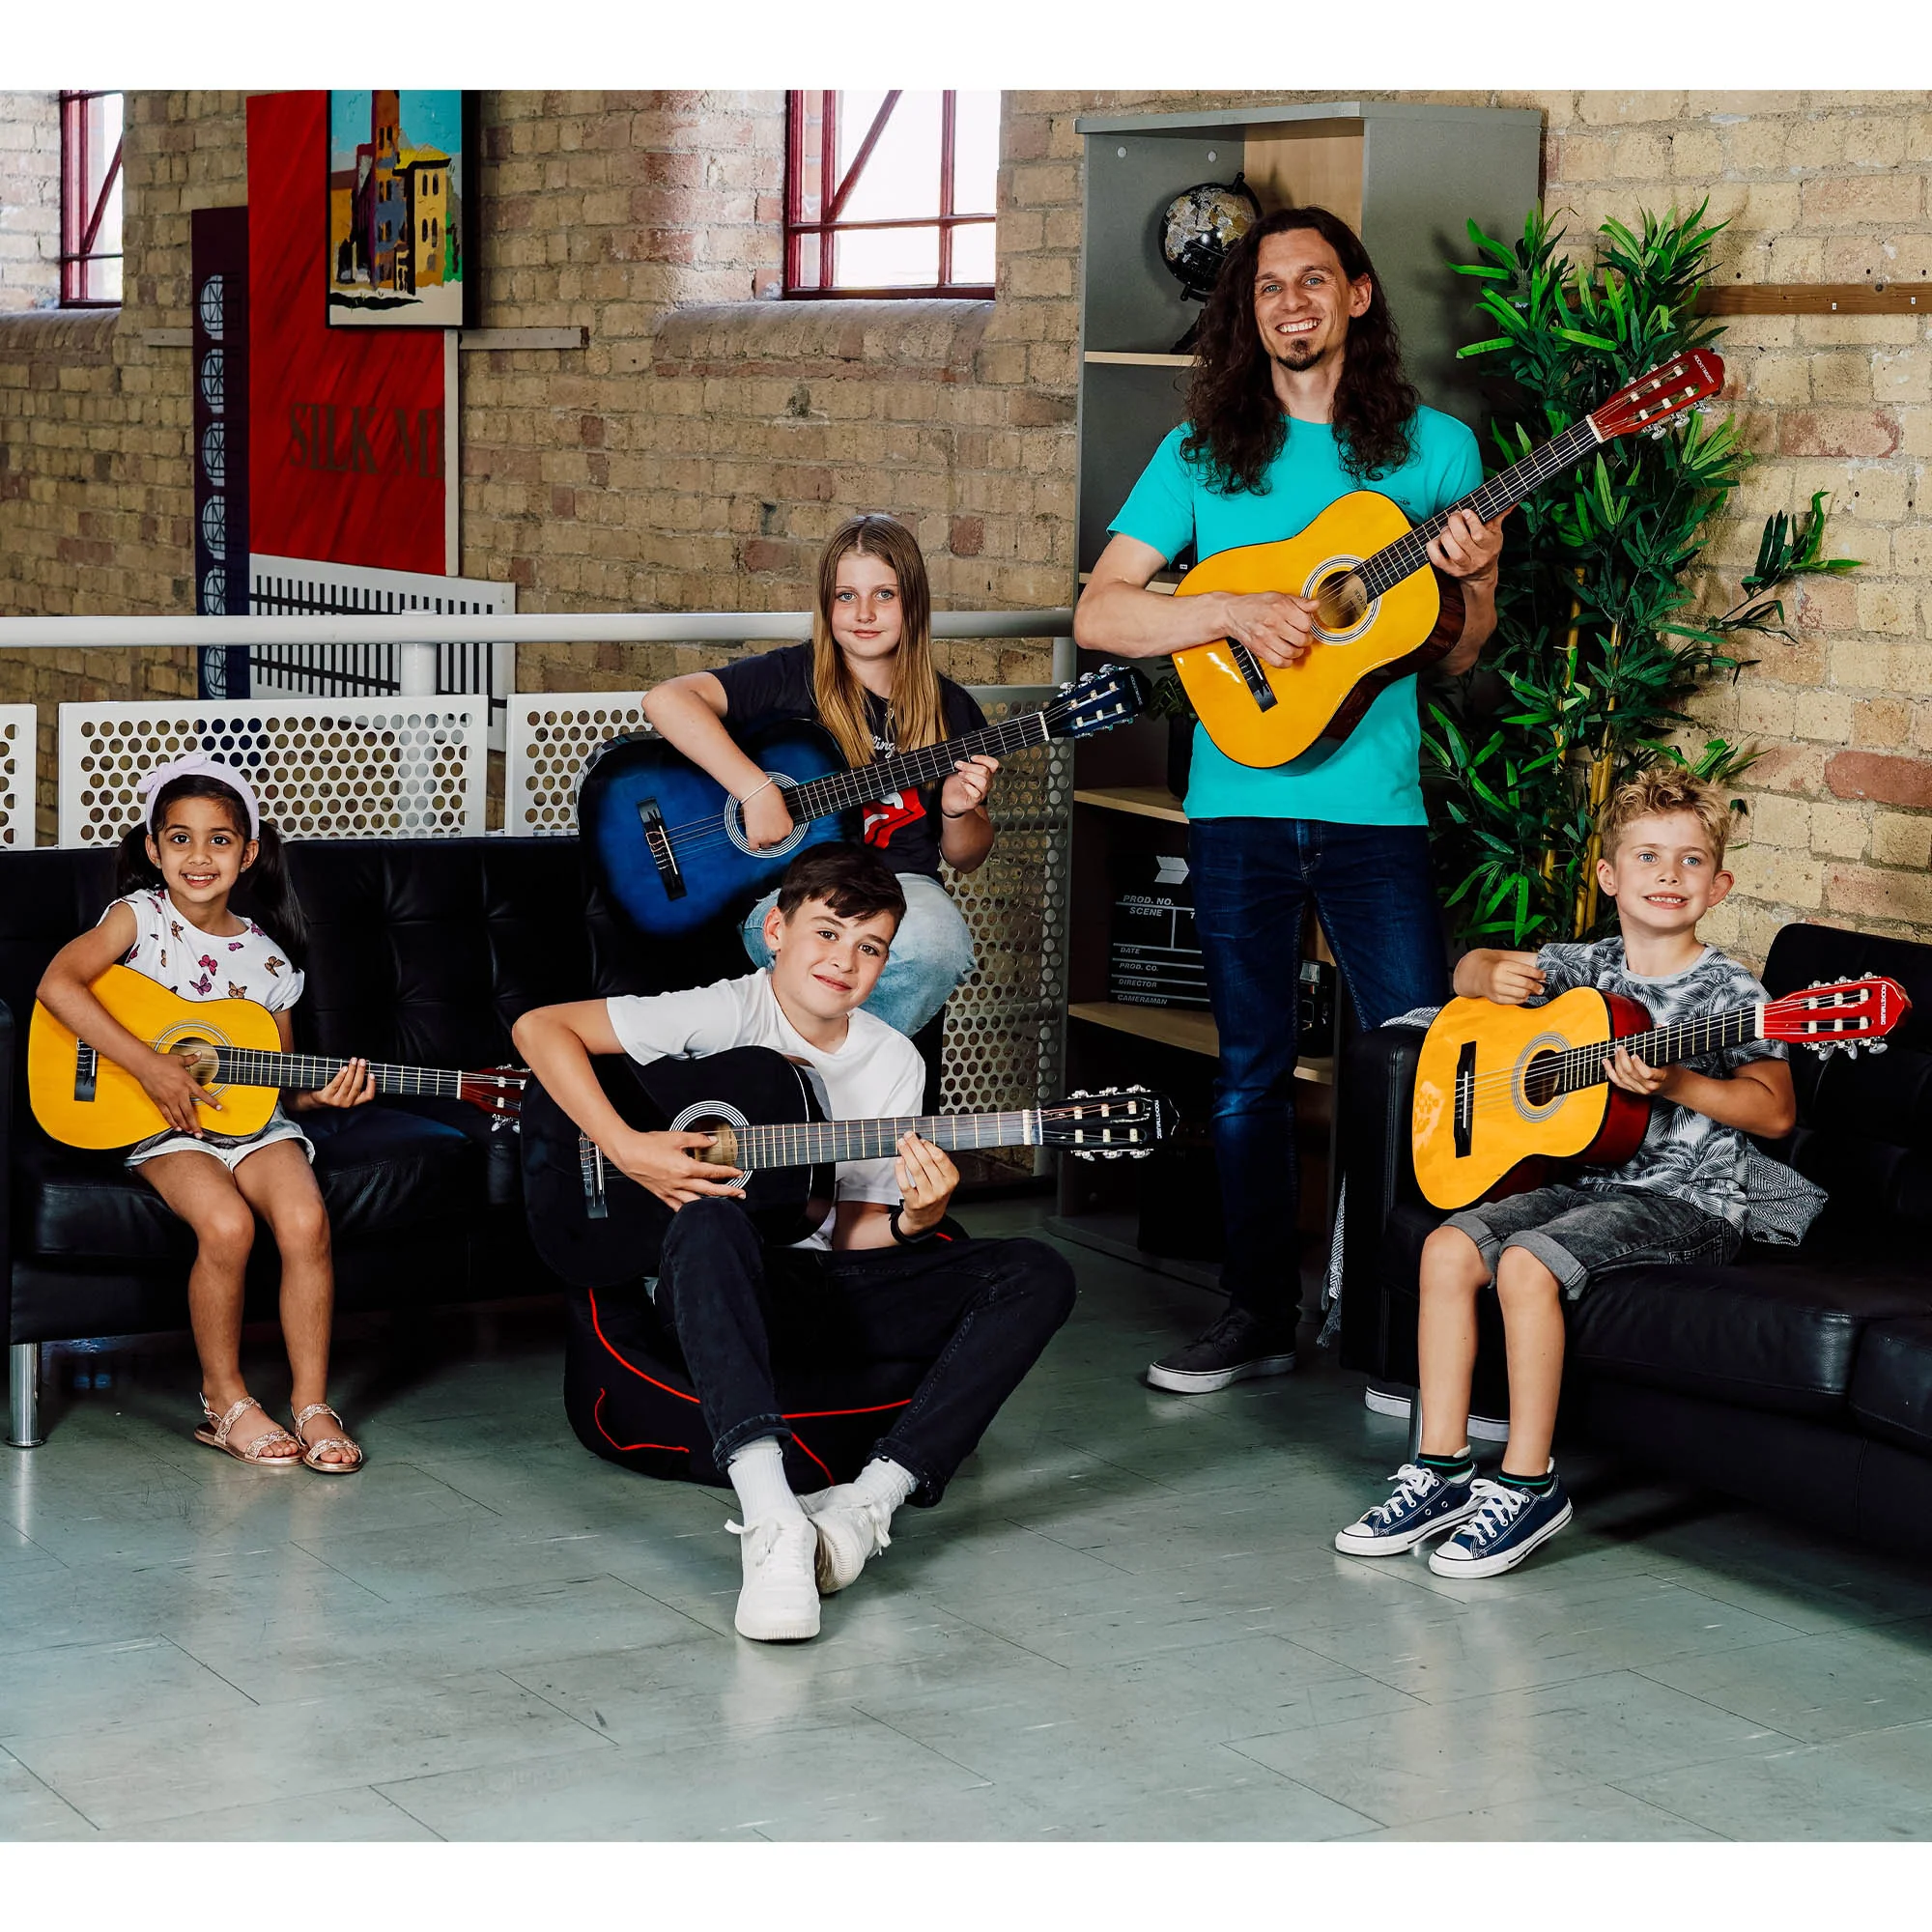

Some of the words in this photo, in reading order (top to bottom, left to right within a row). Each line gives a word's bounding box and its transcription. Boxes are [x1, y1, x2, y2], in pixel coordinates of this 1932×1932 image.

[290, 402, 379, 474] SILK
[871, 735, 895, 759] ling
[1122, 895, 1154, 904] PROD.
[1156, 897, 1175, 906] NO.
[1129, 907, 1163, 917] SCENE
[1119, 962, 1144, 971] PROD.
[1118, 979, 1157, 988] DIRECTOR
[1117, 994, 1168, 1005] CAMERAMAN
